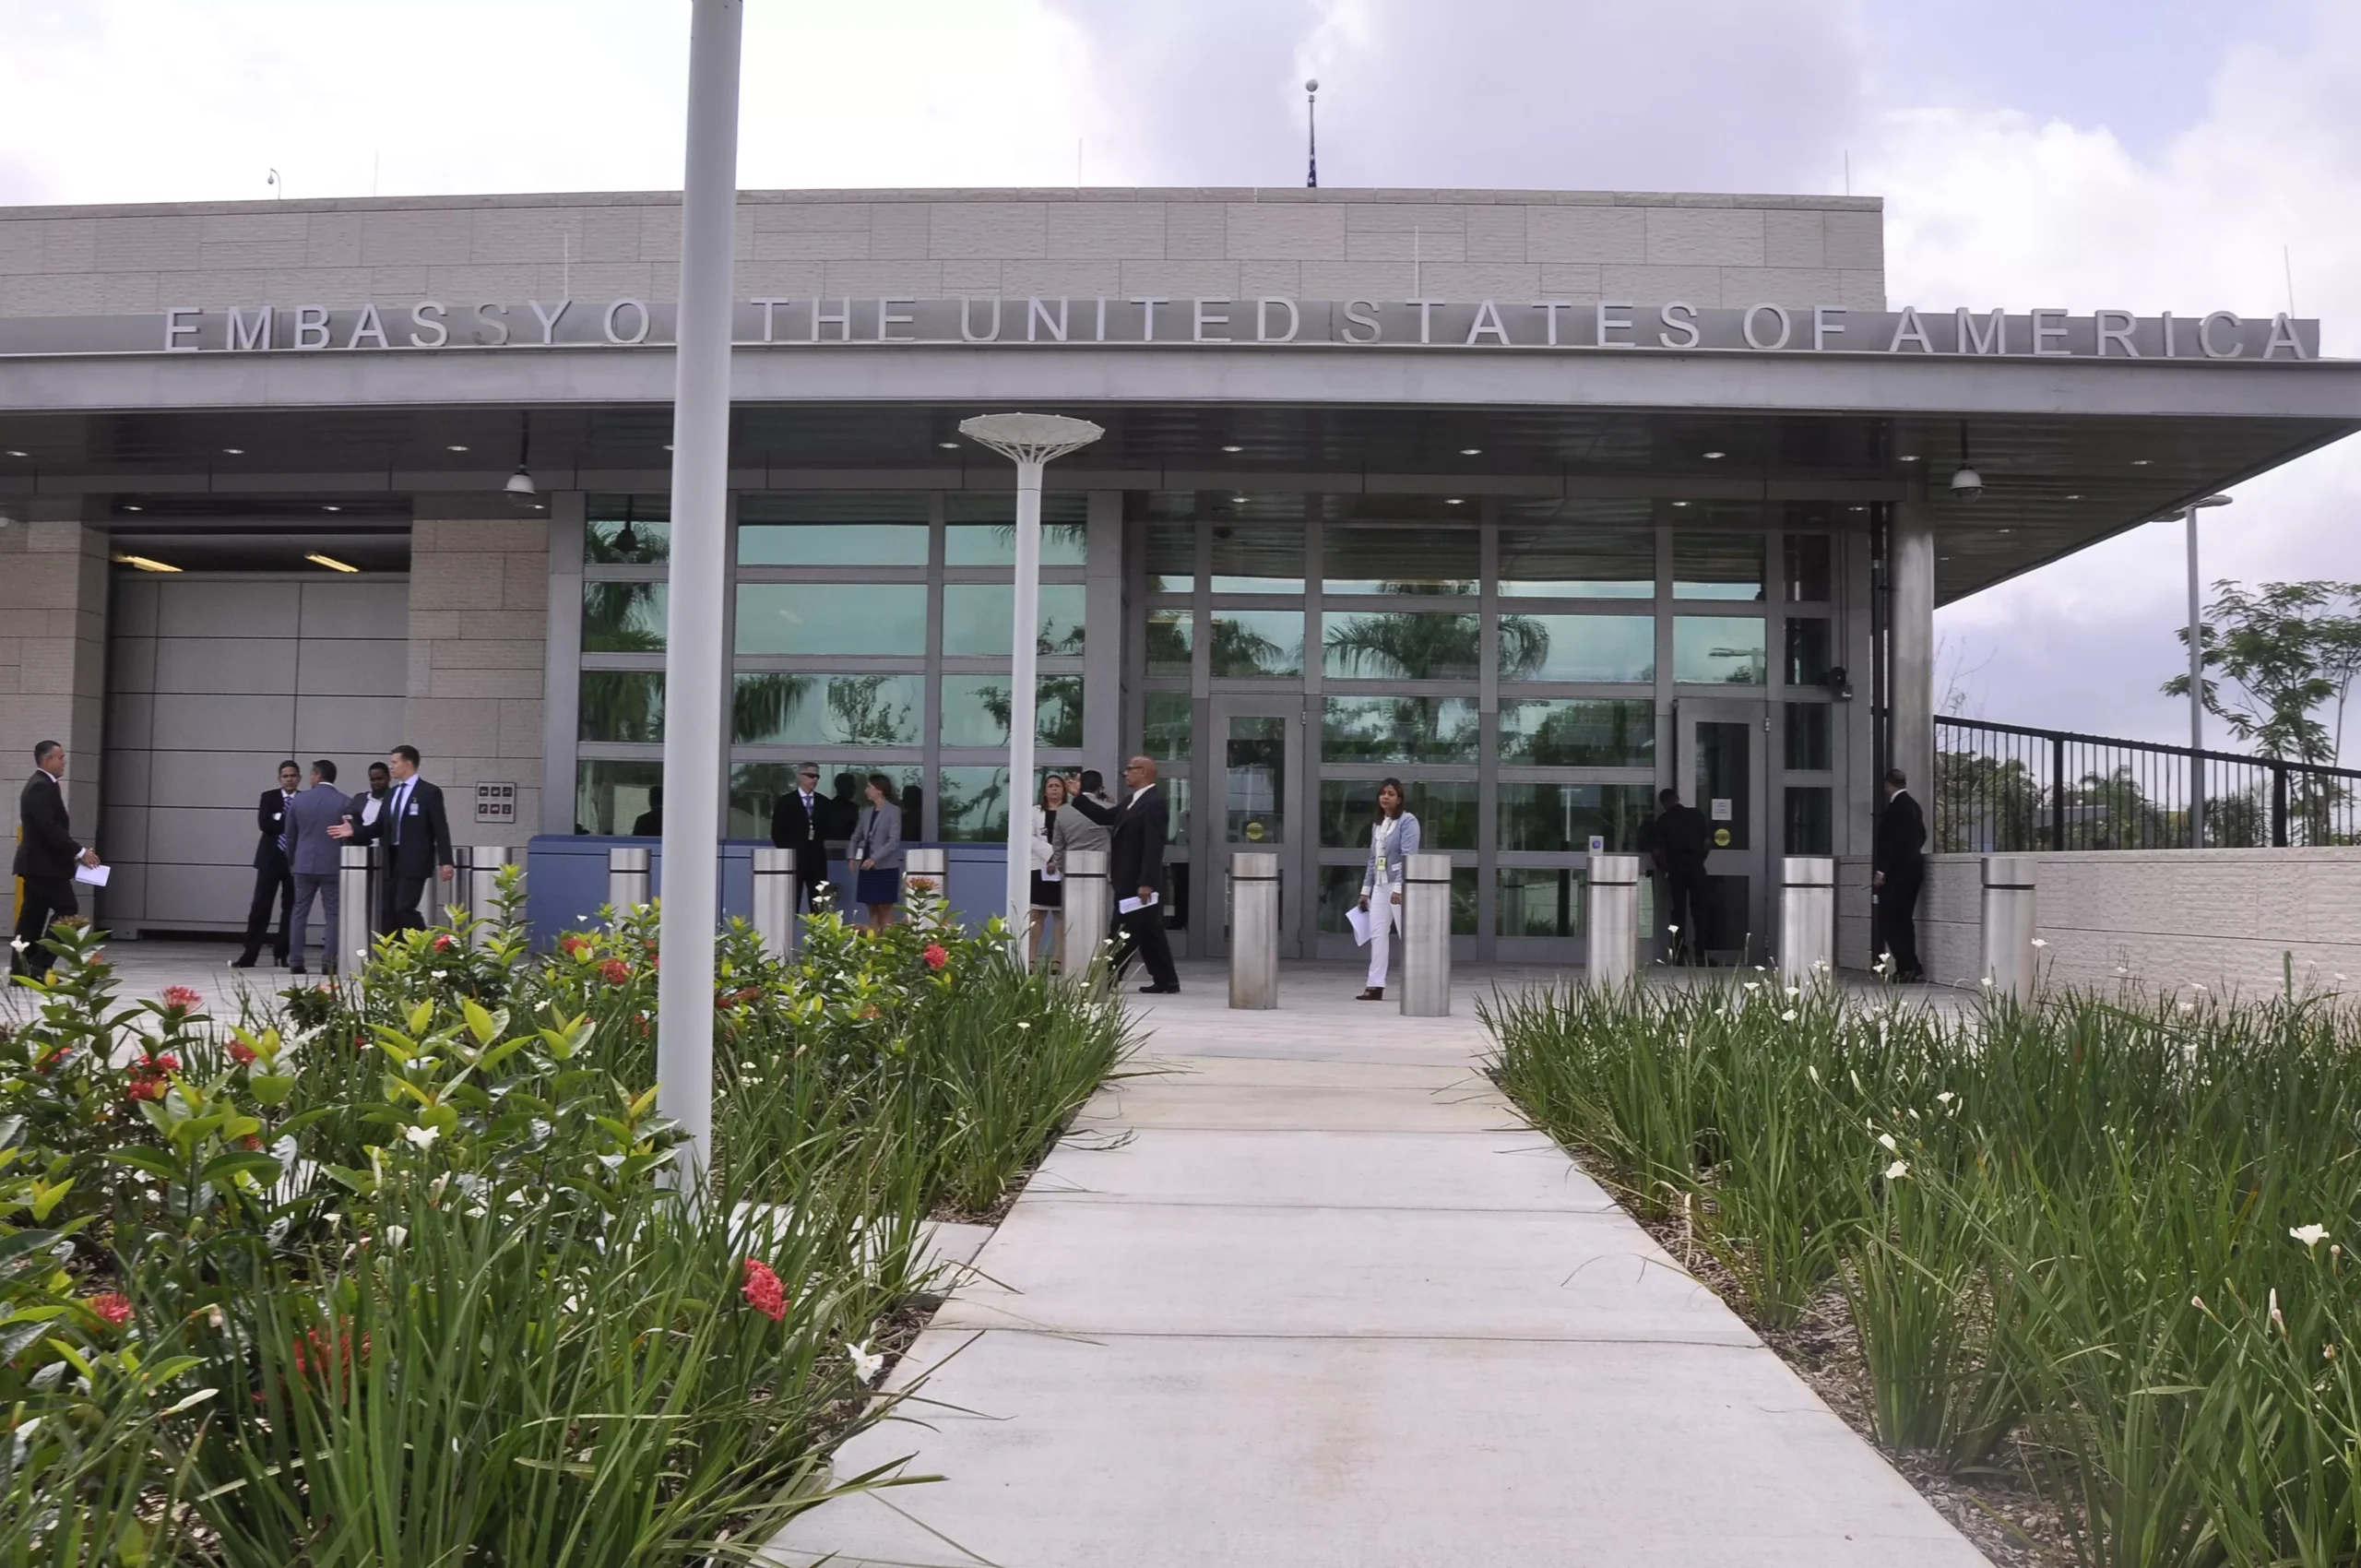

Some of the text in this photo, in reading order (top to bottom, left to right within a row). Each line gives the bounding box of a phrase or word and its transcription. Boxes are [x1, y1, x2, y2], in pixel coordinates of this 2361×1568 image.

[164, 300, 573, 351] EMBASSY
[751, 296, 916, 343] THE
[960, 295, 1300, 343] UNITED
[1341, 297, 1701, 349] STATES
[1742, 302, 1847, 350] OF
[1889, 305, 2308, 360] AMERICA
